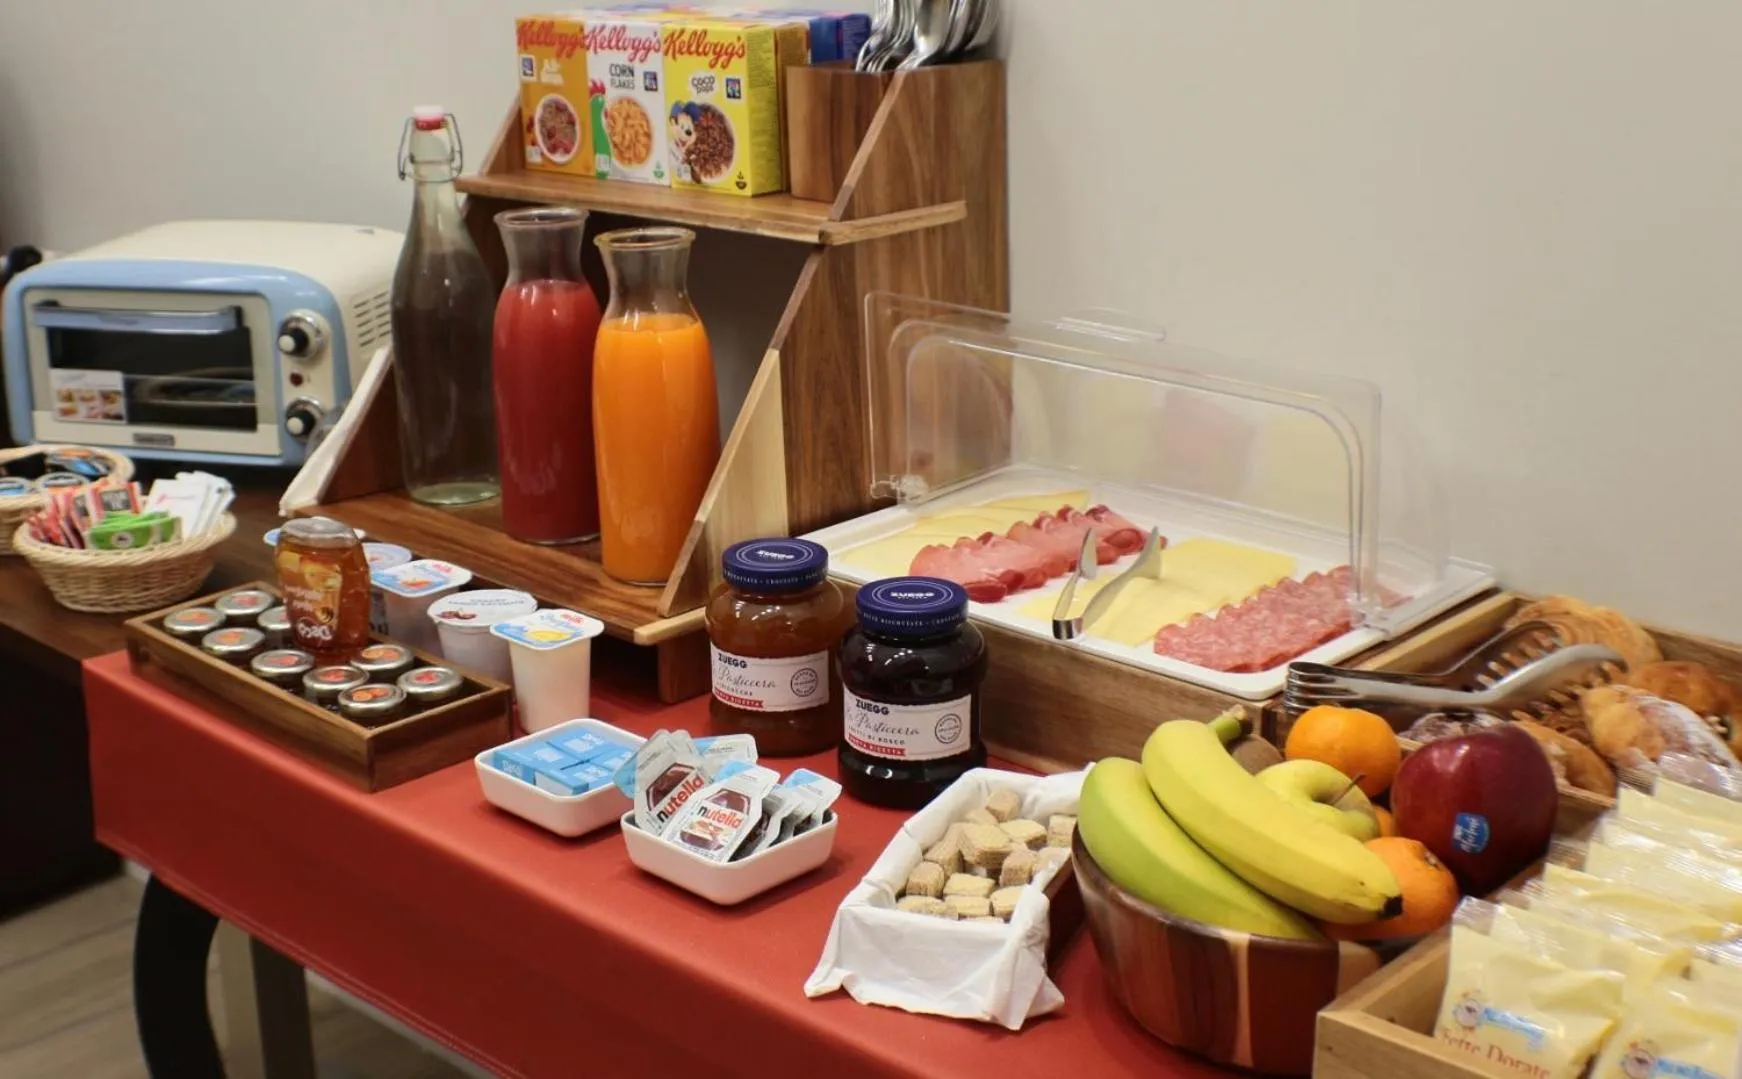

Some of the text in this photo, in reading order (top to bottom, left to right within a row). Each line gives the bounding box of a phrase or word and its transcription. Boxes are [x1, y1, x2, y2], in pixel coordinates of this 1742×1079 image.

[583, 24, 661, 63] Kellogg's
[663, 28, 745, 69] Kellogg's
[609, 63, 635, 77] CORN
[718, 653, 748, 669] ZUEGG
[855, 698, 890, 716] ZUEGG
[656, 773, 705, 824] nutella
[697, 805, 745, 829] nutella
